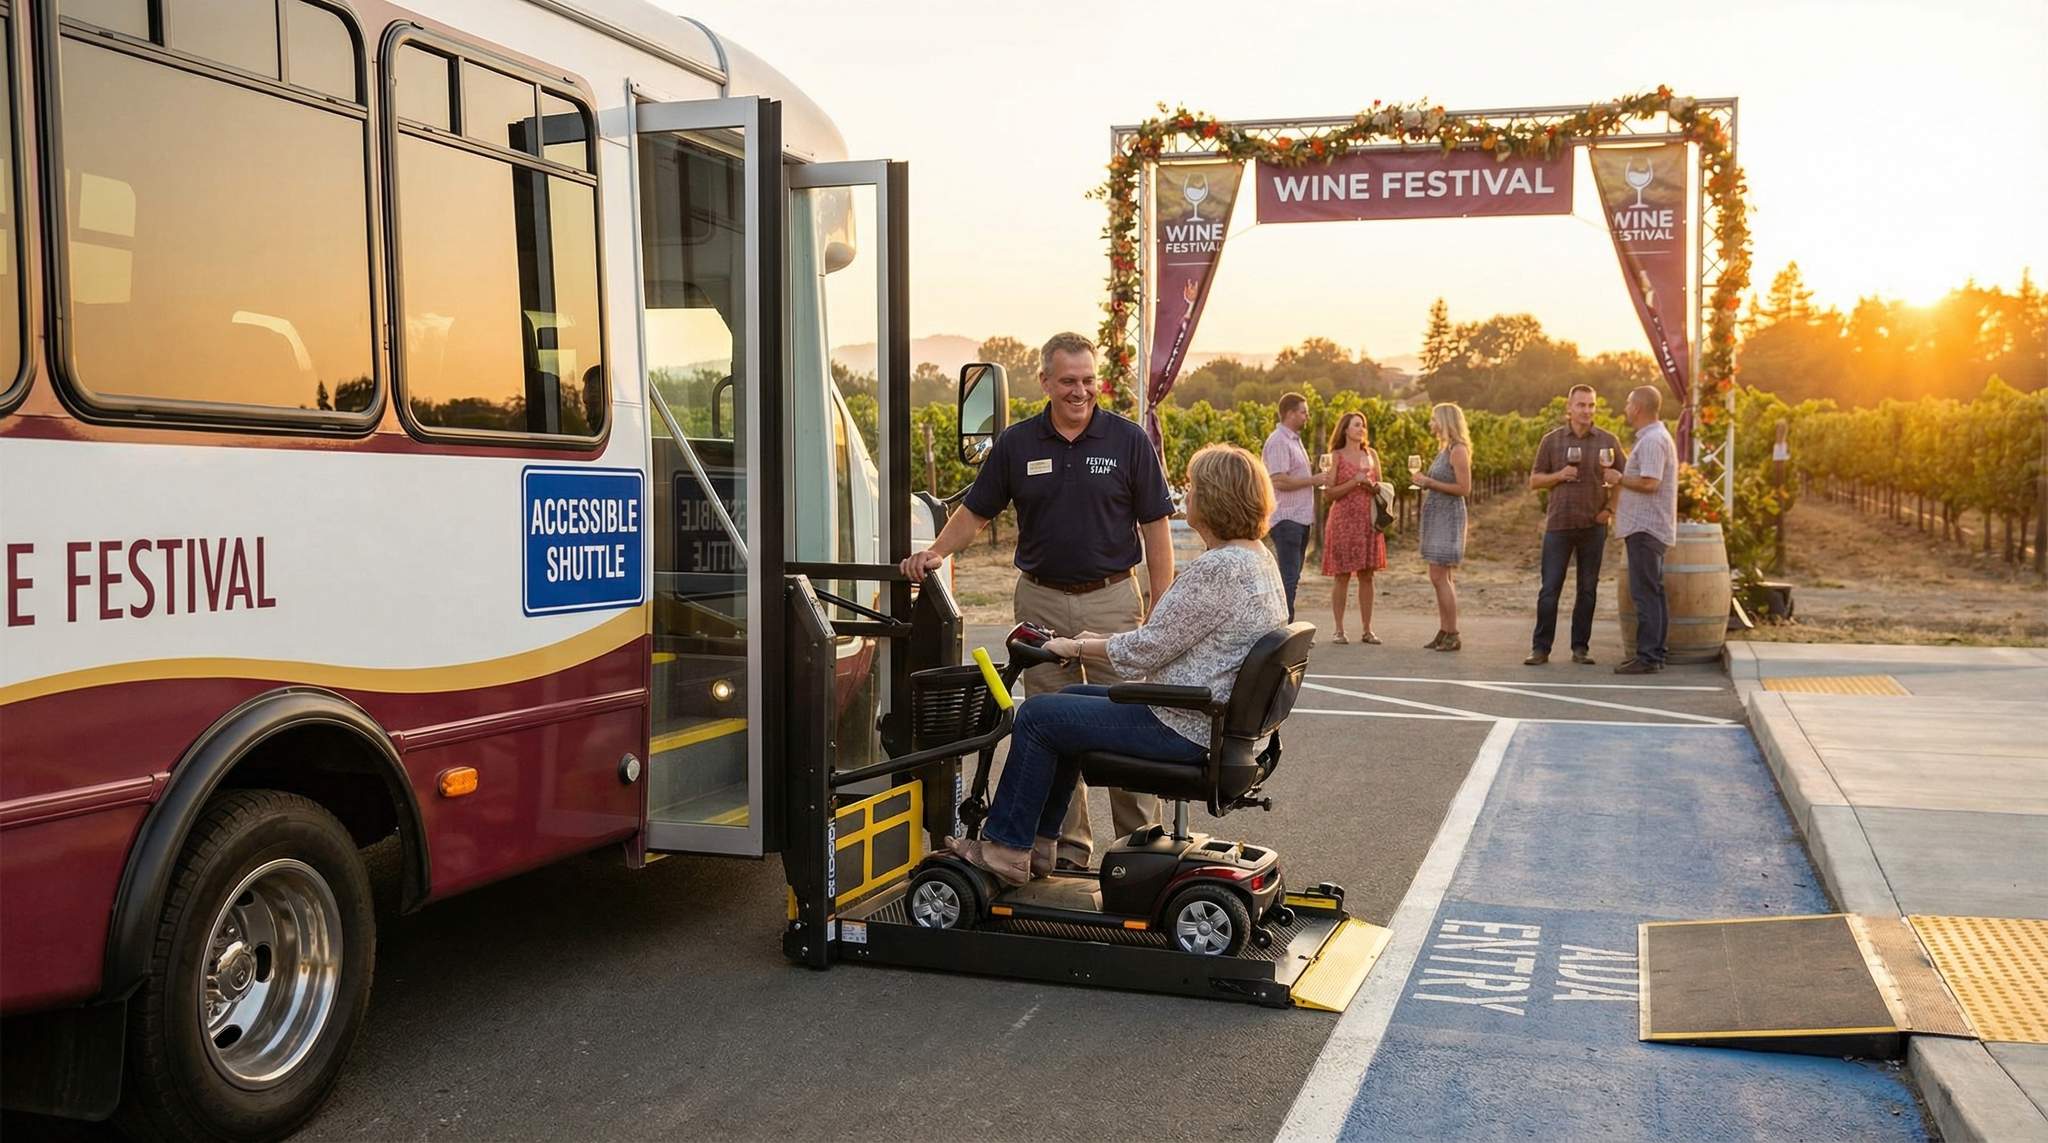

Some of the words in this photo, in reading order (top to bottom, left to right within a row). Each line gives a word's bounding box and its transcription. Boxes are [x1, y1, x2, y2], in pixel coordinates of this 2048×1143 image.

[1273, 173, 1370, 202] WINE
[1382, 167, 1554, 199] FESTIVAL
[1165, 223, 1224, 242] WINE
[530, 498, 638, 535] ACCESSIBLE
[67, 537, 276, 622] FESTIVAL
[546, 544, 625, 583] SHUTTLE
[1413, 919, 1541, 1016] ENTRY
